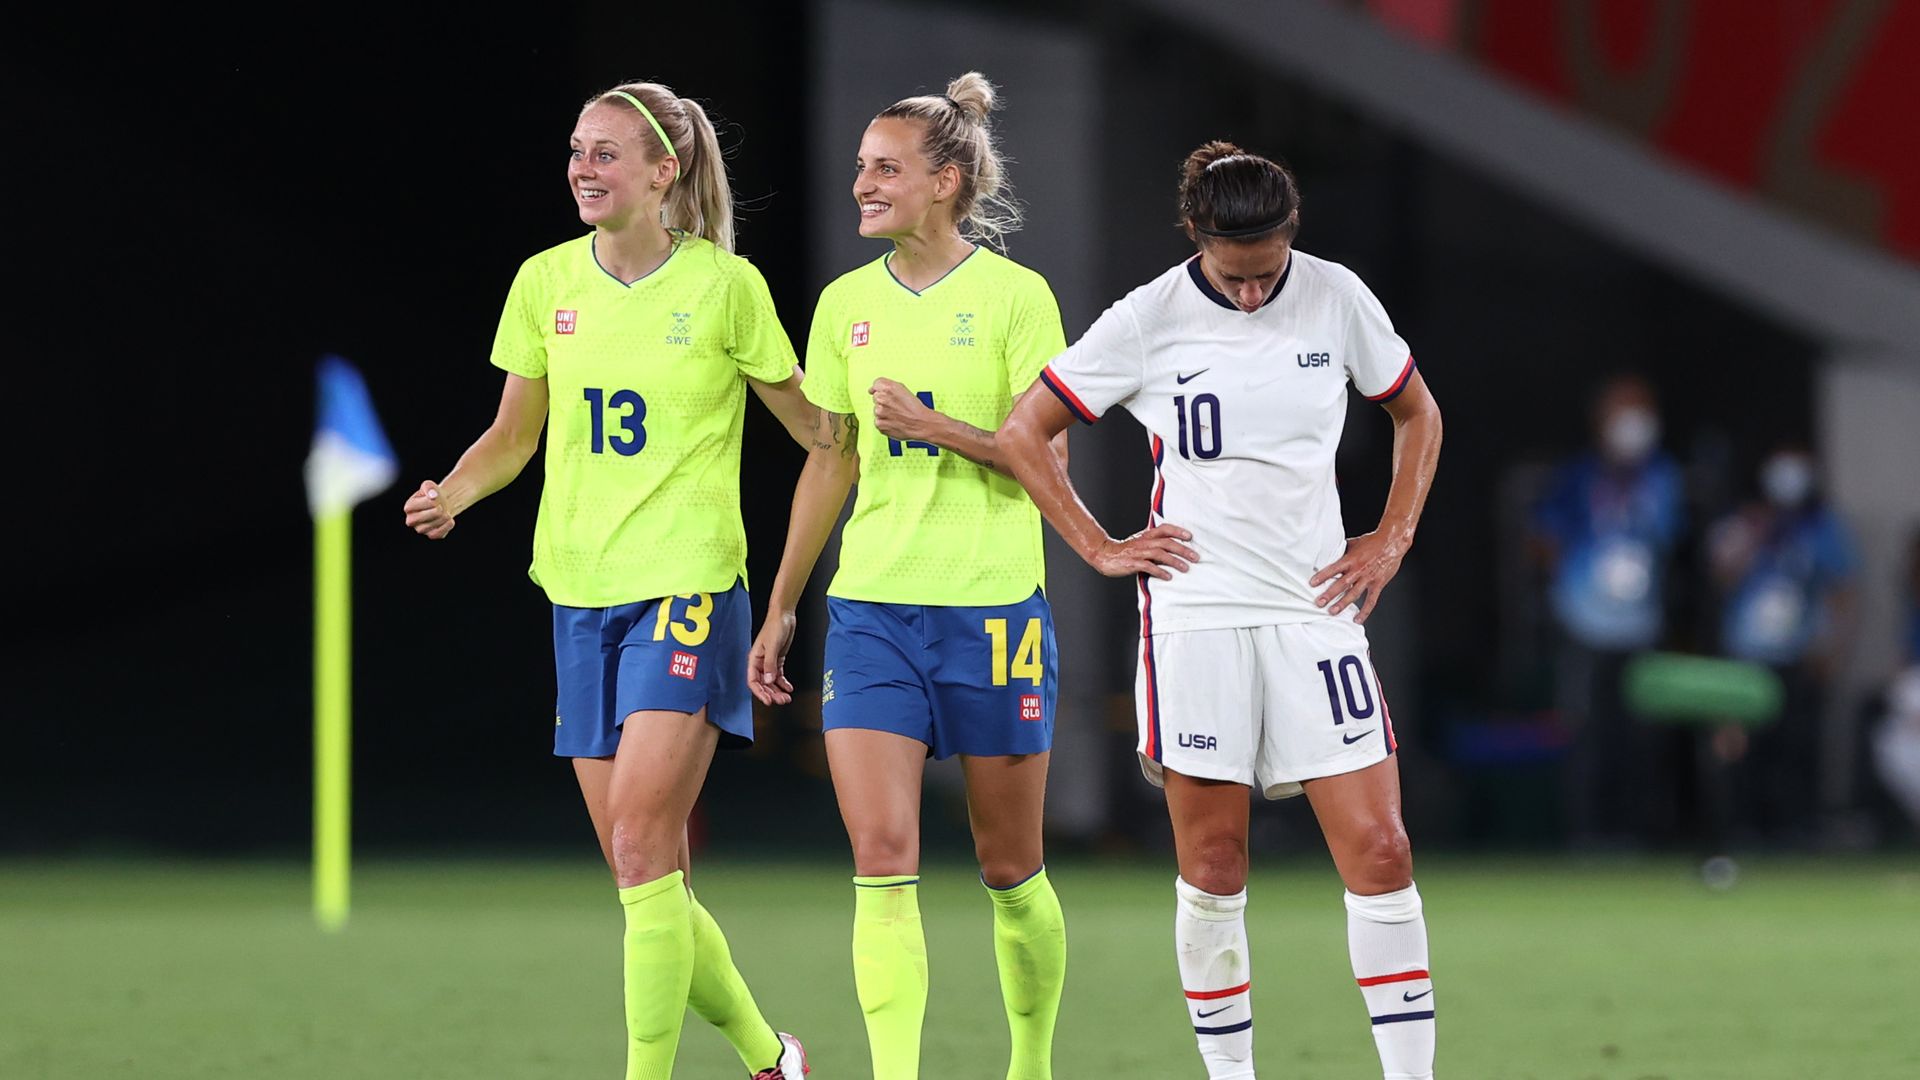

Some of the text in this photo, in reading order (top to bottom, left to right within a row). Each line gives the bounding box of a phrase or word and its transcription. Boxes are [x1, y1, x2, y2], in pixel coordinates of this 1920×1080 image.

[557, 311, 574, 321] UNI
[556, 322, 574, 333] QLO
[665, 335, 692, 345] SWE
[949, 336, 975, 346] SWE
[1297, 352, 1330, 368] USA
[583, 387, 647, 457] 13
[1173, 392, 1222, 460] 10
[652, 592, 714, 647] 13
[984, 617, 1044, 687] 14
[674, 653, 693, 667] UNI
[672, 663, 693, 676] QLO
[1317, 654, 1375, 726] 10
[1023, 697, 1039, 708] UNI
[1022, 708, 1041, 719] QLO
[1178, 732, 1217, 751] USA
